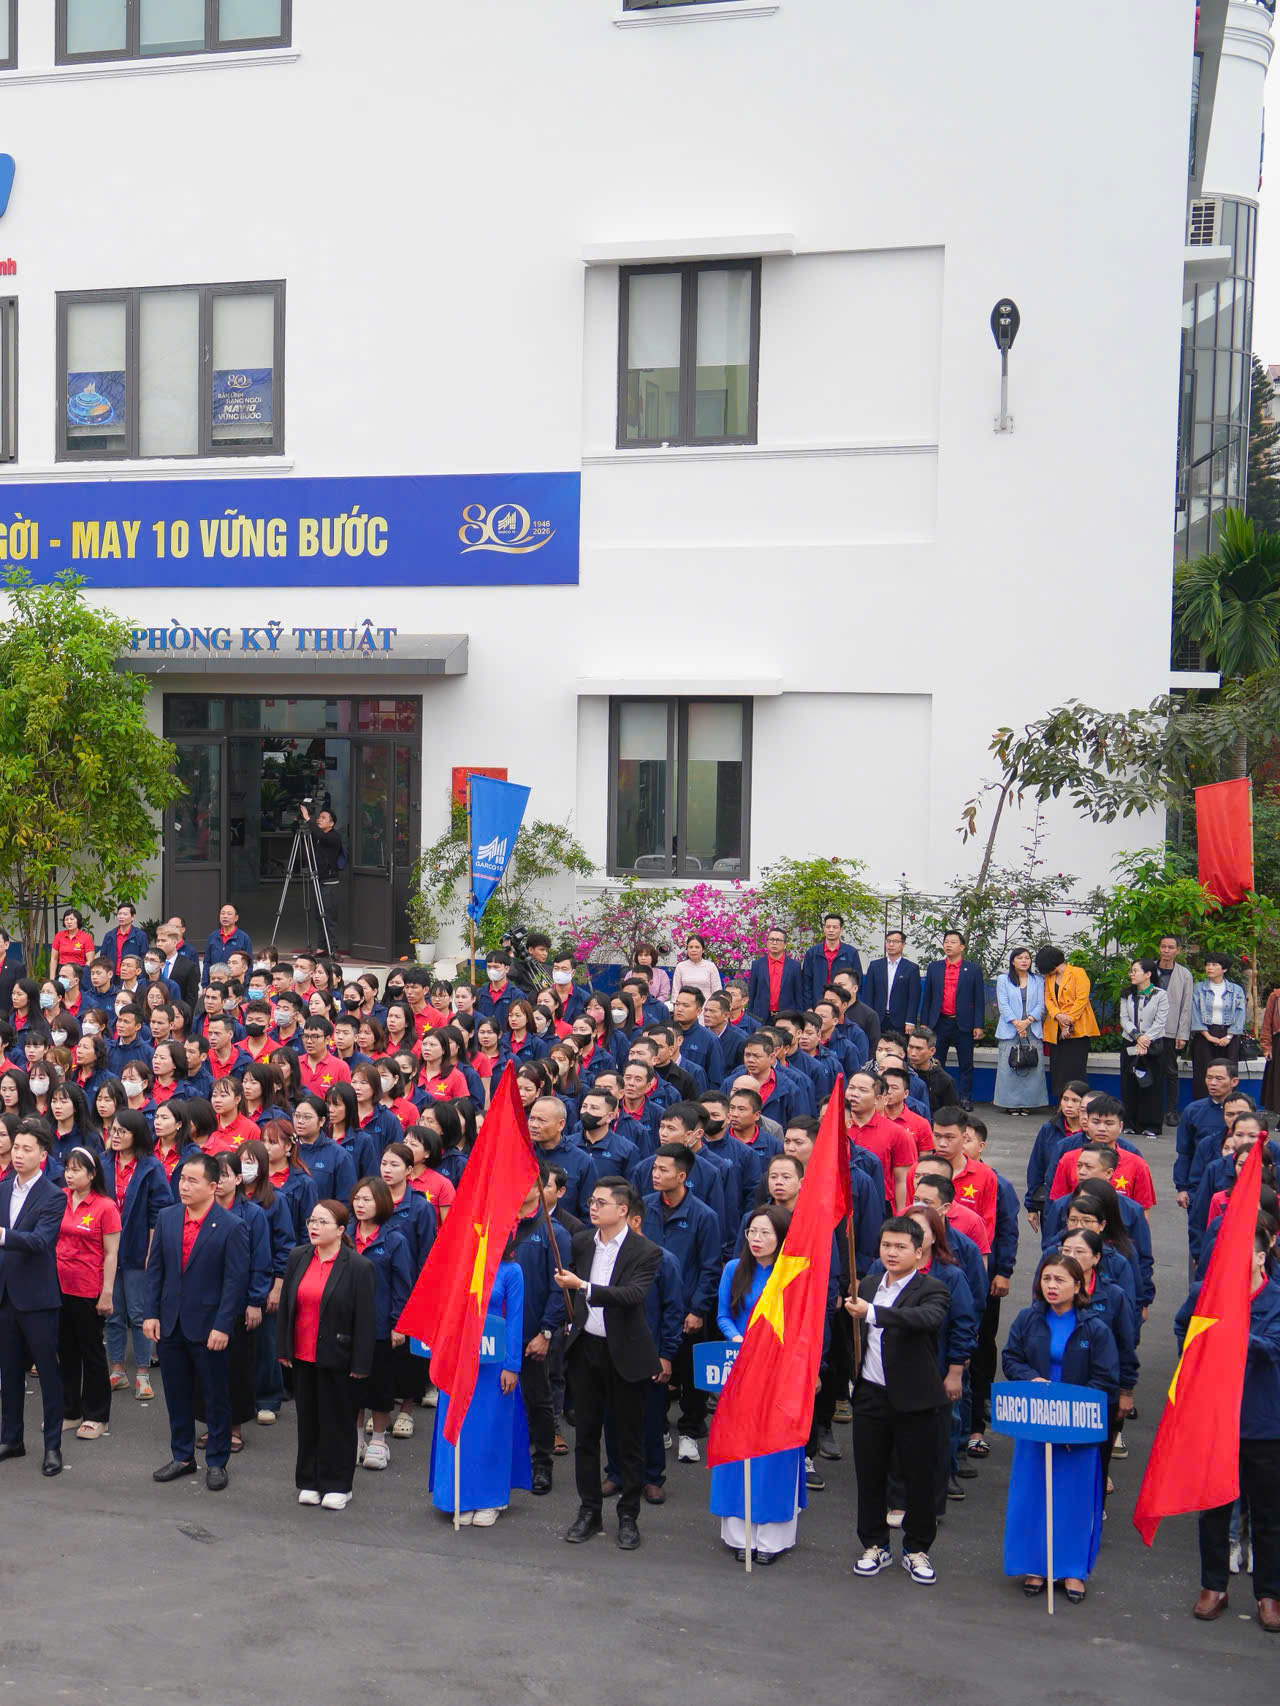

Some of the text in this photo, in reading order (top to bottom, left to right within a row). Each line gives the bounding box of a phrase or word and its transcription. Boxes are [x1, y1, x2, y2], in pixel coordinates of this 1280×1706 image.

[71, 520, 141, 560] MAY
[152, 520, 188, 559] 10
[199, 508, 288, 559] VỮNG
[299, 505, 389, 558] BƯỚC
[130, 618, 398, 657] PHÒNG KỸ THUẬT
[995, 1394, 1104, 1430] GARCO DRAGON HOTEL
